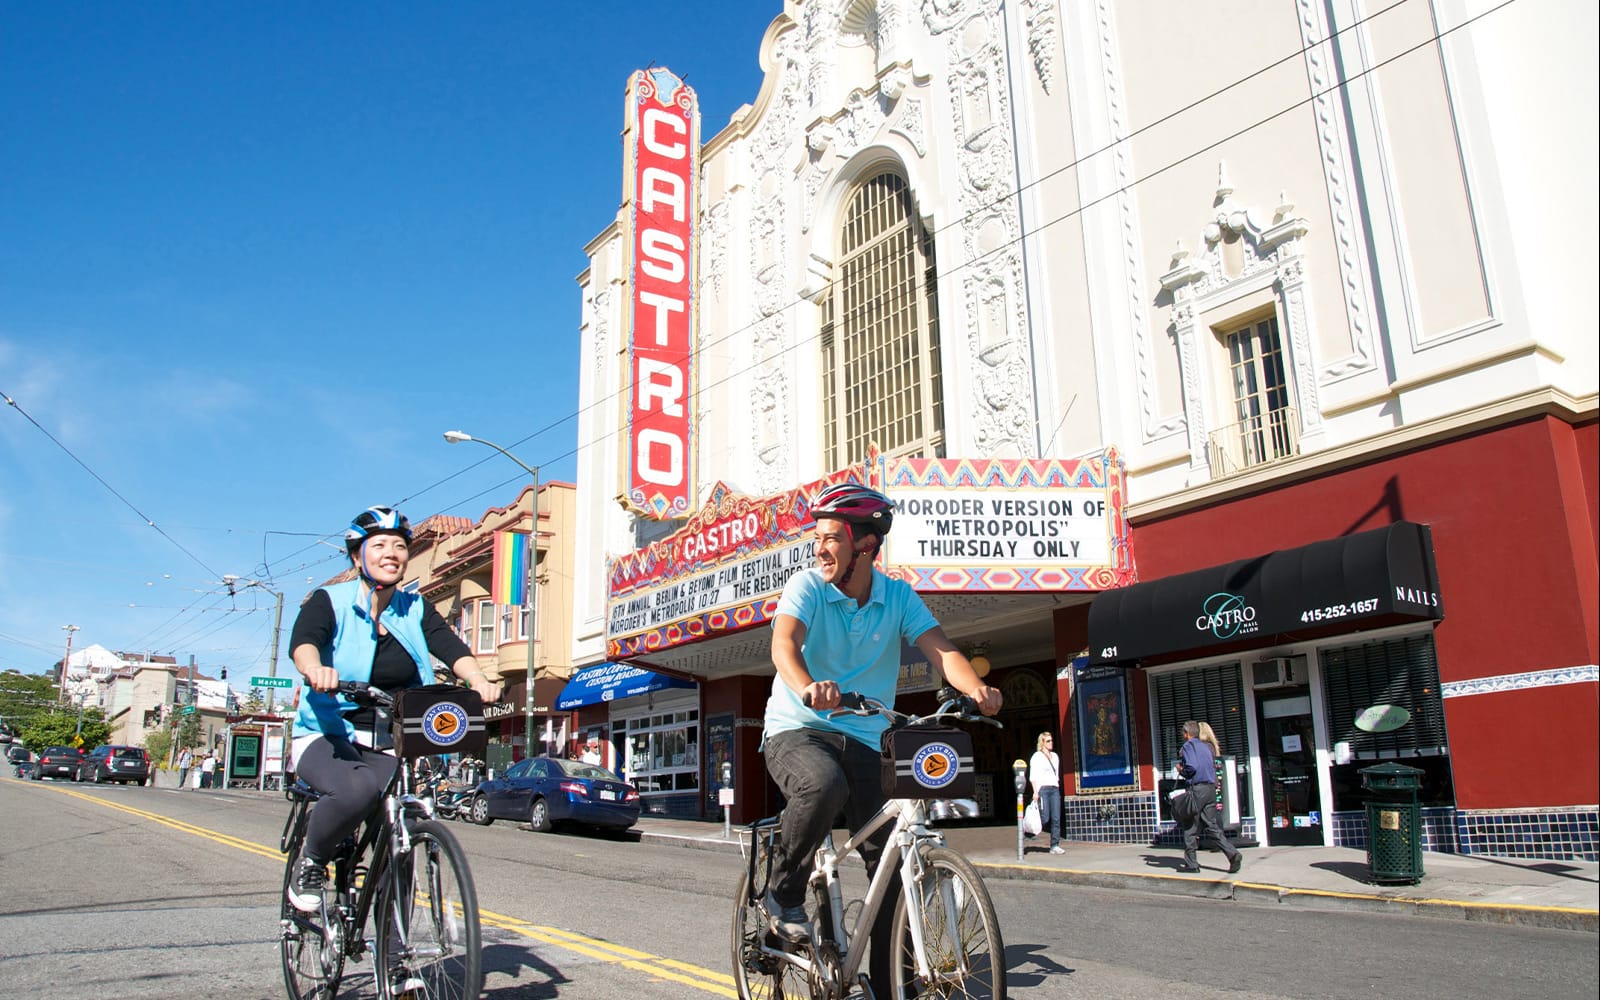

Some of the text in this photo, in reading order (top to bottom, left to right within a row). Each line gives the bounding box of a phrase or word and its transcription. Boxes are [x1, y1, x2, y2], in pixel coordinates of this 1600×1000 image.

[638, 107, 687, 487] CASTRO
[893, 499, 1105, 517] MORODER VERSION OF
[684, 513, 758, 560] CASTRO
[918, 540, 1080, 558] THURSDAY ONLY
[627, 596, 651, 614] ANNUAL
[655, 585, 679, 606] BERLIN
[680, 583, 686, 598] &
[688, 574, 716, 595] BEYOND
[718, 566, 738, 585] FILM
[742, 553, 782, 580] FESTIVAL
[651, 596, 696, 623] METROPOLIS
[733, 580, 752, 599] THE
[754, 575, 771, 594] RED
[1395, 586, 1438, 607] NAILS
[1196, 606, 1256, 631] CASTRO
[1300, 598, 1379, 623] 415-252-1657
[1239, 627, 1259, 635] SALON
[1101, 646, 1118, 659] 431
[257, 679, 287, 687] Market
[576, 667, 608, 682] CASTRO
[585, 674, 615, 688] CUSTOM
[426, 709, 437, 722] BAY
[453, 707, 465, 721] BIKE
[916, 750, 927, 764] BAY
[943, 748, 956, 762] BIKE
